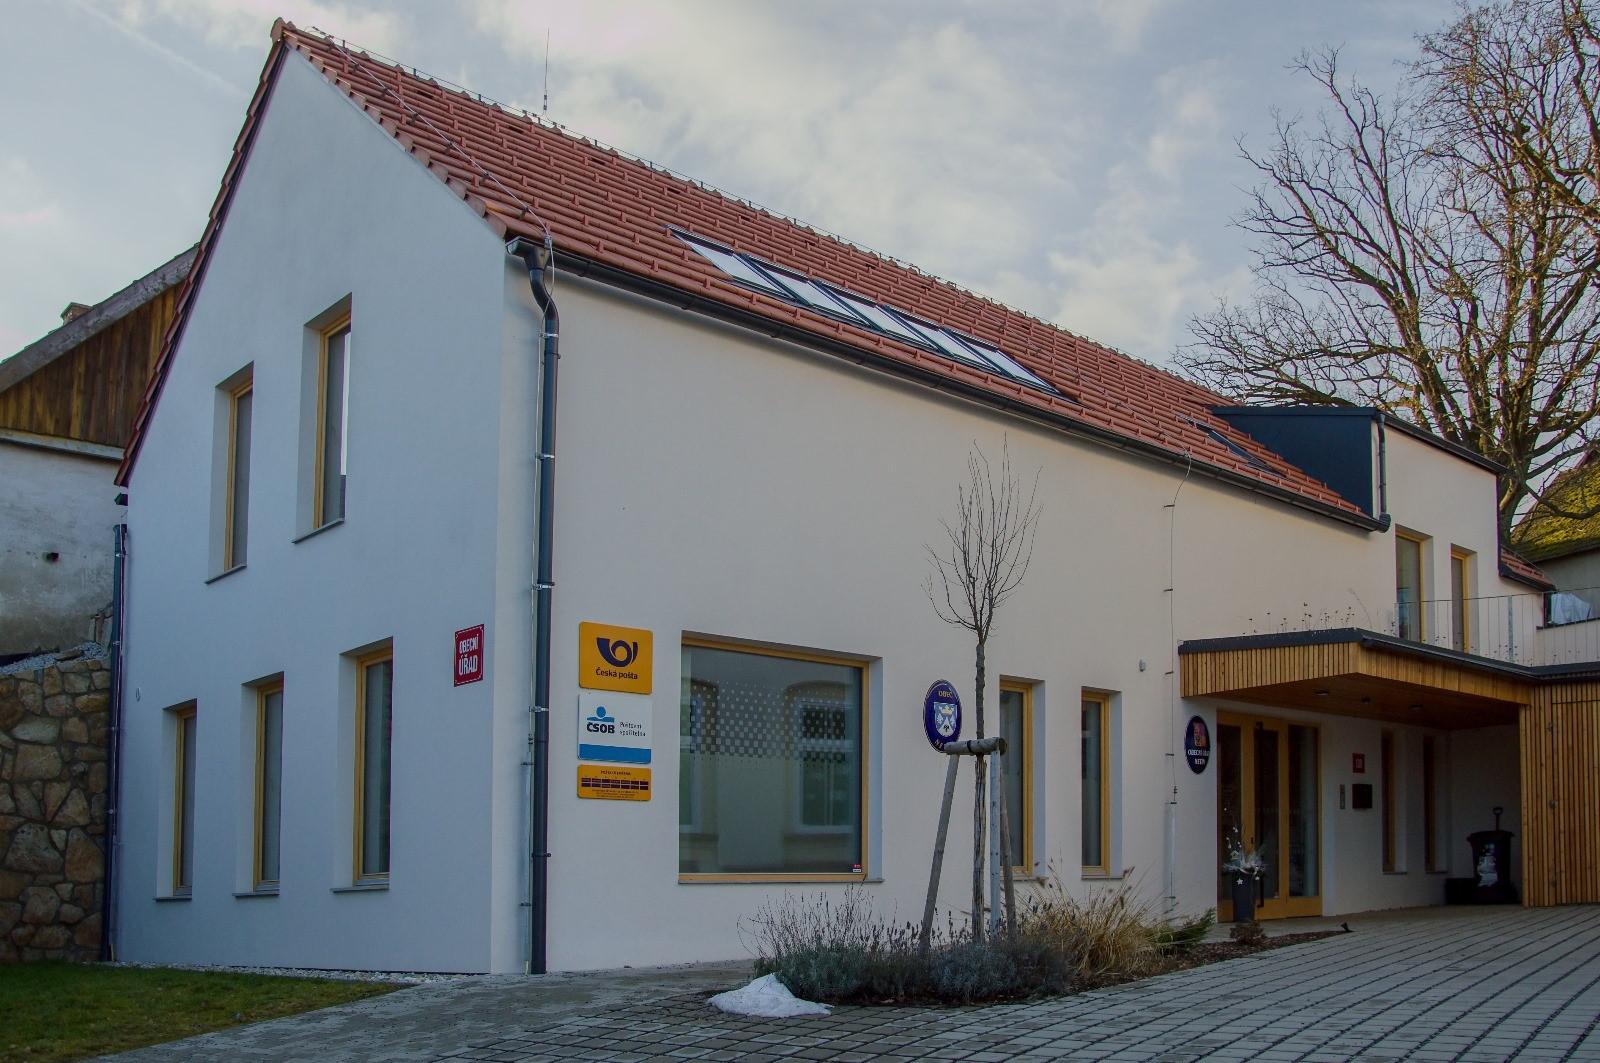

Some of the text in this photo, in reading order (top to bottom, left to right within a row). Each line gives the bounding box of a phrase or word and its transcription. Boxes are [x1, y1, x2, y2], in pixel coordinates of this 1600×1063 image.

[459, 634, 479, 654] OBECNÍ
[459, 653, 478, 676] ÚŘAD
[595, 667, 638, 680] Česká pošta
[586, 722, 615, 734] ČSOB
